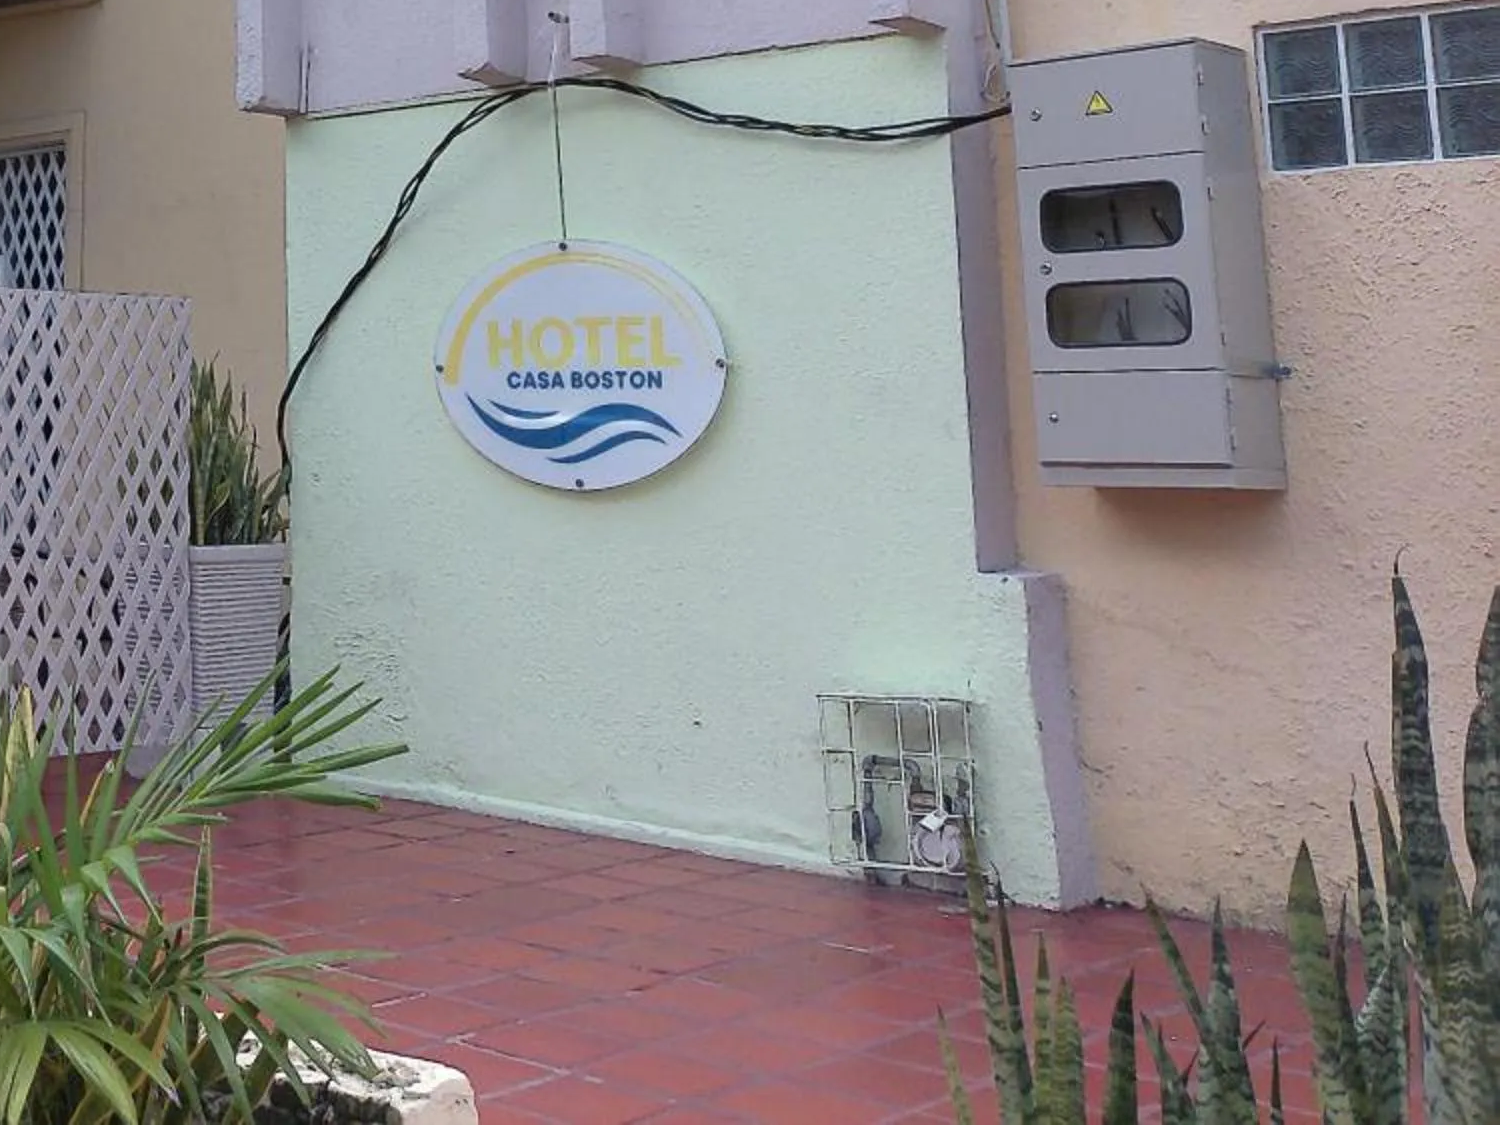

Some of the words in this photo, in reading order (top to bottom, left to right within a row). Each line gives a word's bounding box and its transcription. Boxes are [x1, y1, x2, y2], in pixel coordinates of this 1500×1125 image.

[487, 315, 684, 369] HOTEL
[506, 370, 565, 390] CASA
[571, 370, 663, 390] BOSTON
